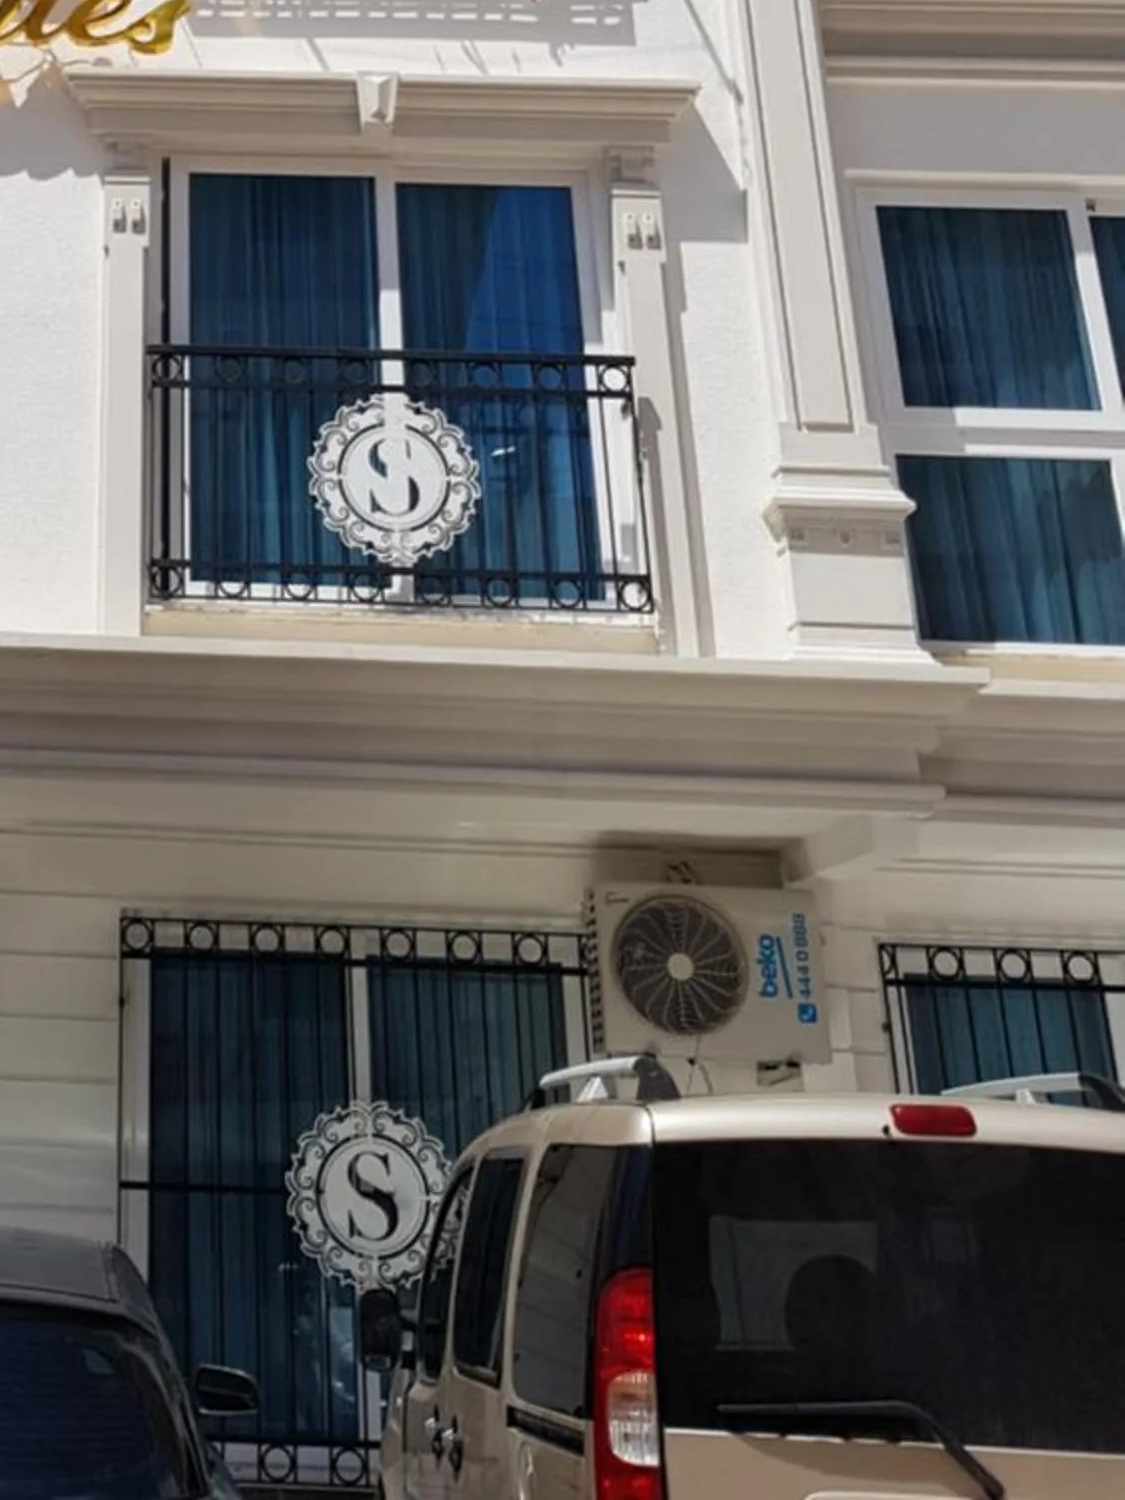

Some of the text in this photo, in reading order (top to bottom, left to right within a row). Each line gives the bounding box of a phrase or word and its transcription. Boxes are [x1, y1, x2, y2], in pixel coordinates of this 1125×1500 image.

[368, 437, 420, 516] S
[756, 934, 778, 998] beko
[346, 1150, 400, 1242] S
